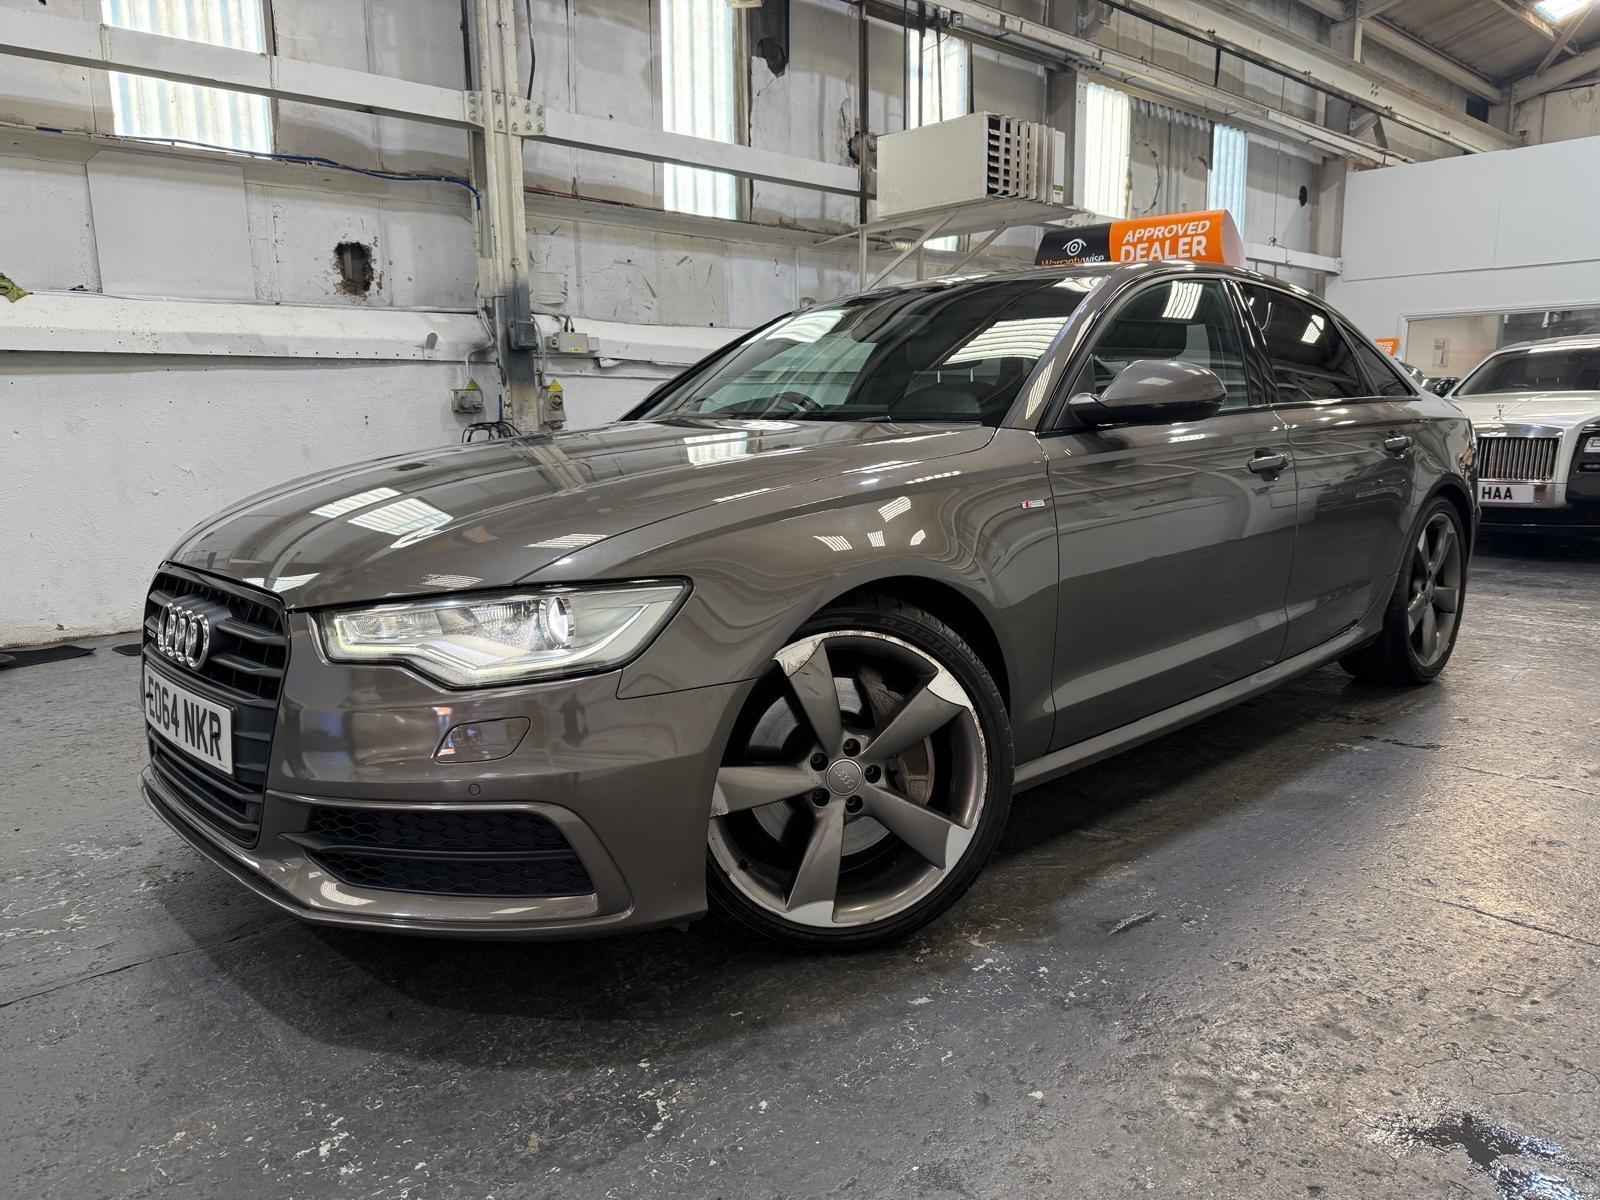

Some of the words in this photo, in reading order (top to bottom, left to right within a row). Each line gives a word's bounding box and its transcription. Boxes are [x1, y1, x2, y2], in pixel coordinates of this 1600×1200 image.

[1123, 220, 1210, 244] APPROVED
[1120, 236, 1207, 263] DEALER
[1481, 486, 1513, 500] HAA
[183, 698, 222, 761] NKR
